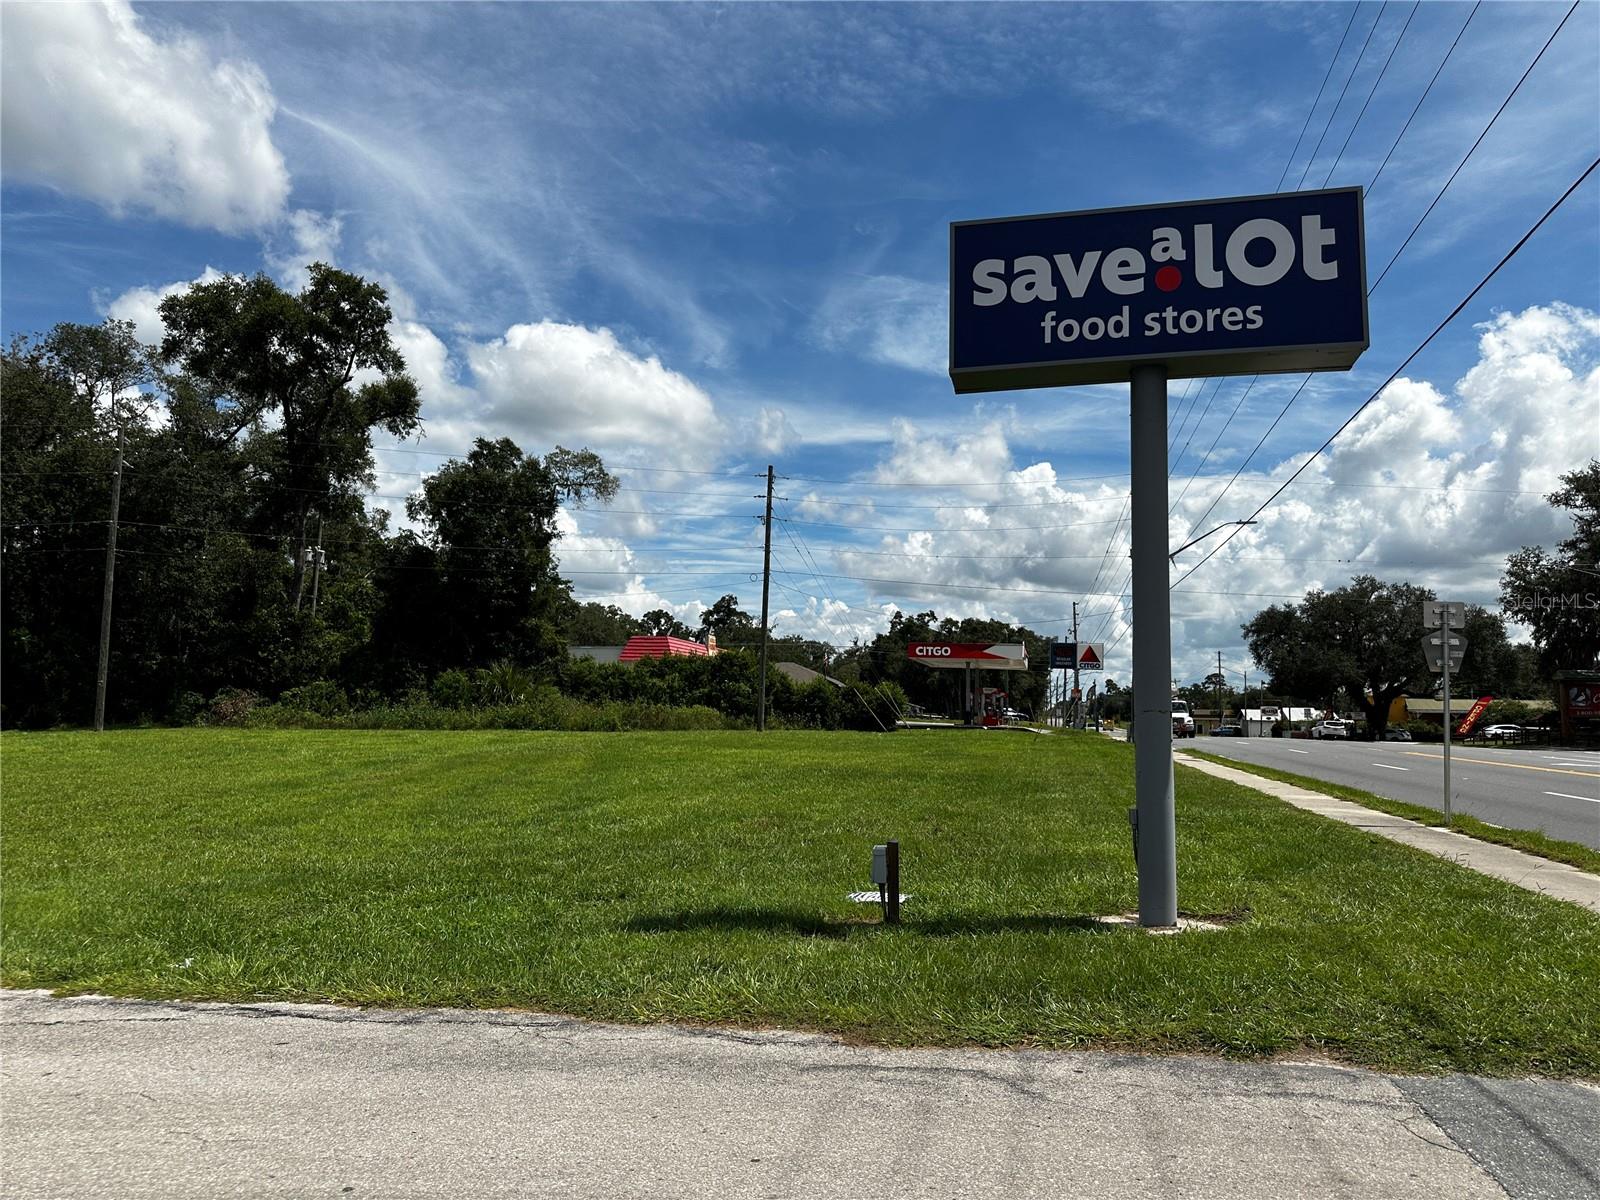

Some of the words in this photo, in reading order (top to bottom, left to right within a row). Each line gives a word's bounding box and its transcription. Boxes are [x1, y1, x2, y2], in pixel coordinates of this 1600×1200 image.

[972, 248, 1146, 307] save
[1041, 306, 1130, 344] food
[1144, 306, 1264, 336] stores
[915, 646, 951, 656] CITGO
